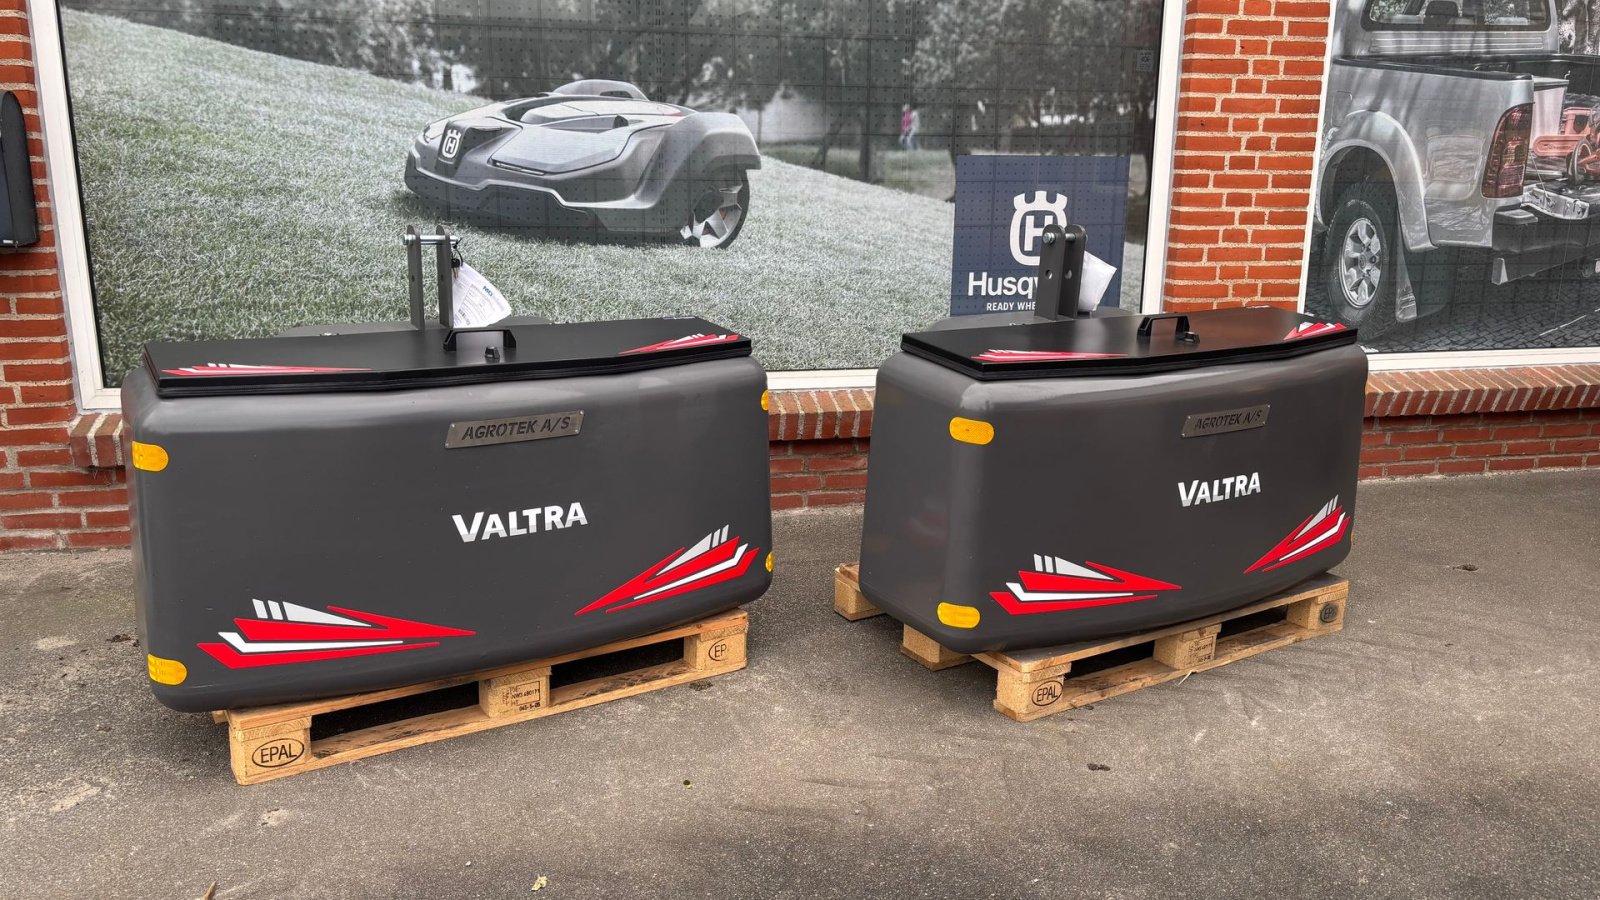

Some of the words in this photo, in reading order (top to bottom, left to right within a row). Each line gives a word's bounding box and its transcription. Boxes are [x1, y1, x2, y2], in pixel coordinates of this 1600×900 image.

[986, 302, 1015, 311] READY
[461, 419, 539, 441] AGROTEK
[540, 416, 571, 433] A/S
[1193, 412, 1243, 431] AGROTEK
[1242, 409, 1263, 425] A/S
[1177, 471, 1261, 508] VALTRA
[451, 501, 589, 543] VALTRA
[1036, 684, 1059, 703] EPAL
[260, 743, 298, 764] EPAL
